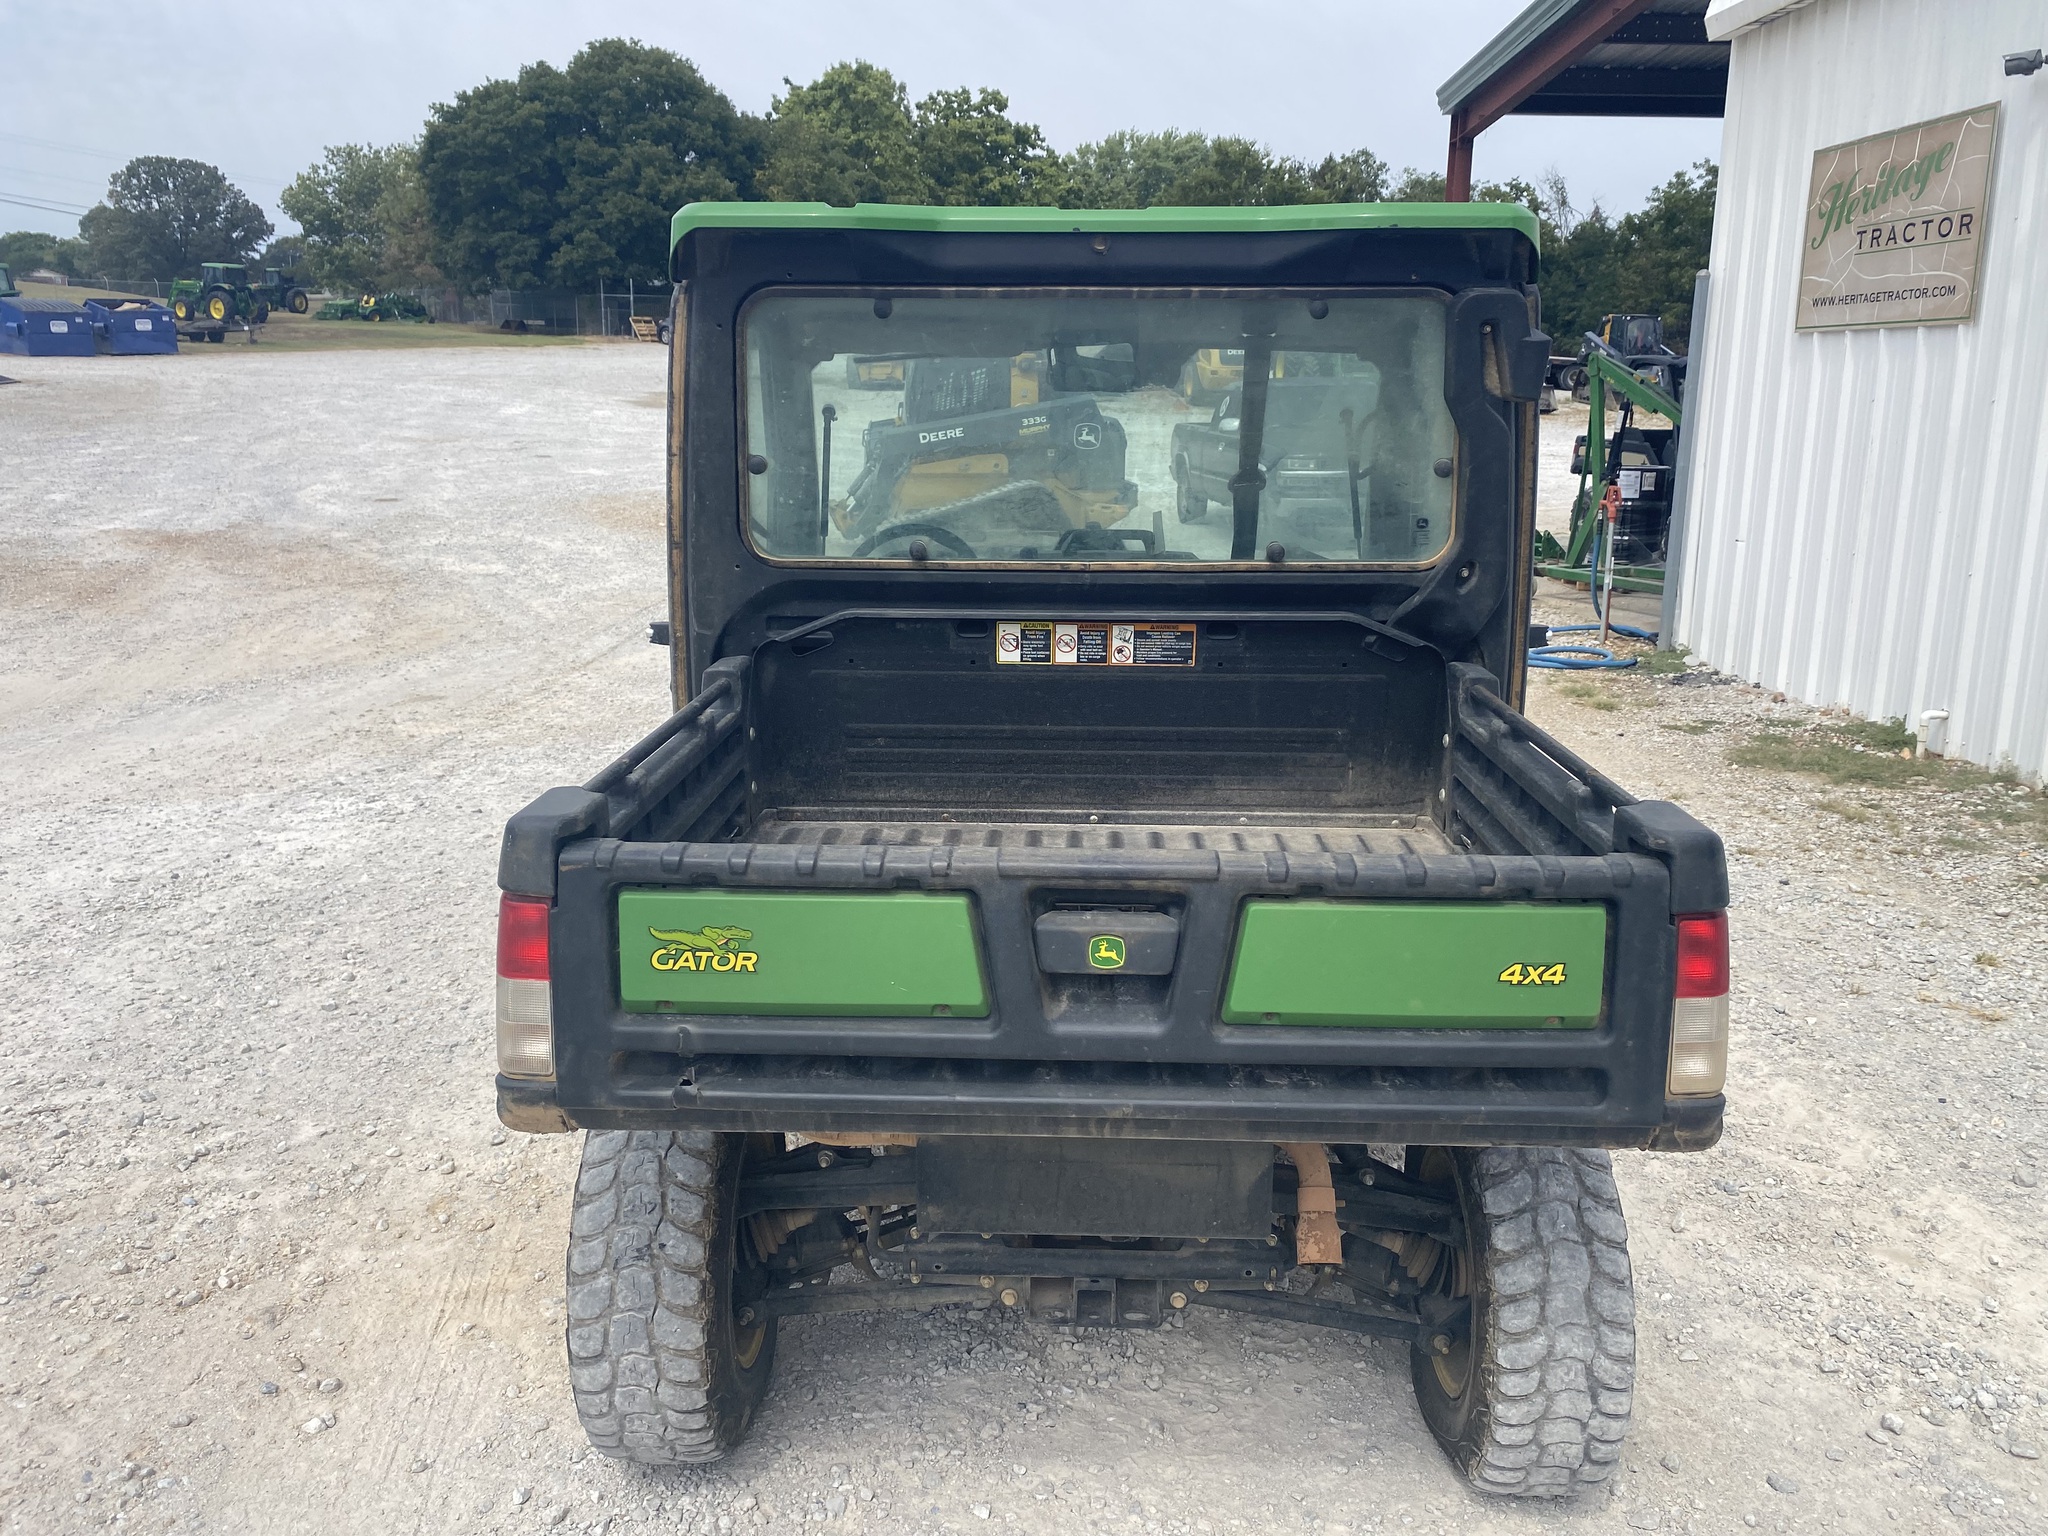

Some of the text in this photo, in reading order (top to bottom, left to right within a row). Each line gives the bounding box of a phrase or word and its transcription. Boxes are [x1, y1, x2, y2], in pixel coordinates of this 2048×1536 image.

[1811, 141, 1954, 250] Heritage
[1856, 213, 1974, 250] TRACTOR
[1812, 285, 1956, 308] WWW.HERITAGETRACTOR.COM
[1021, 416, 1047, 426] 333G
[919, 427, 965, 444] DEERE
[650, 948, 759, 973] GATOR
[1498, 962, 1567, 986] 4x4
